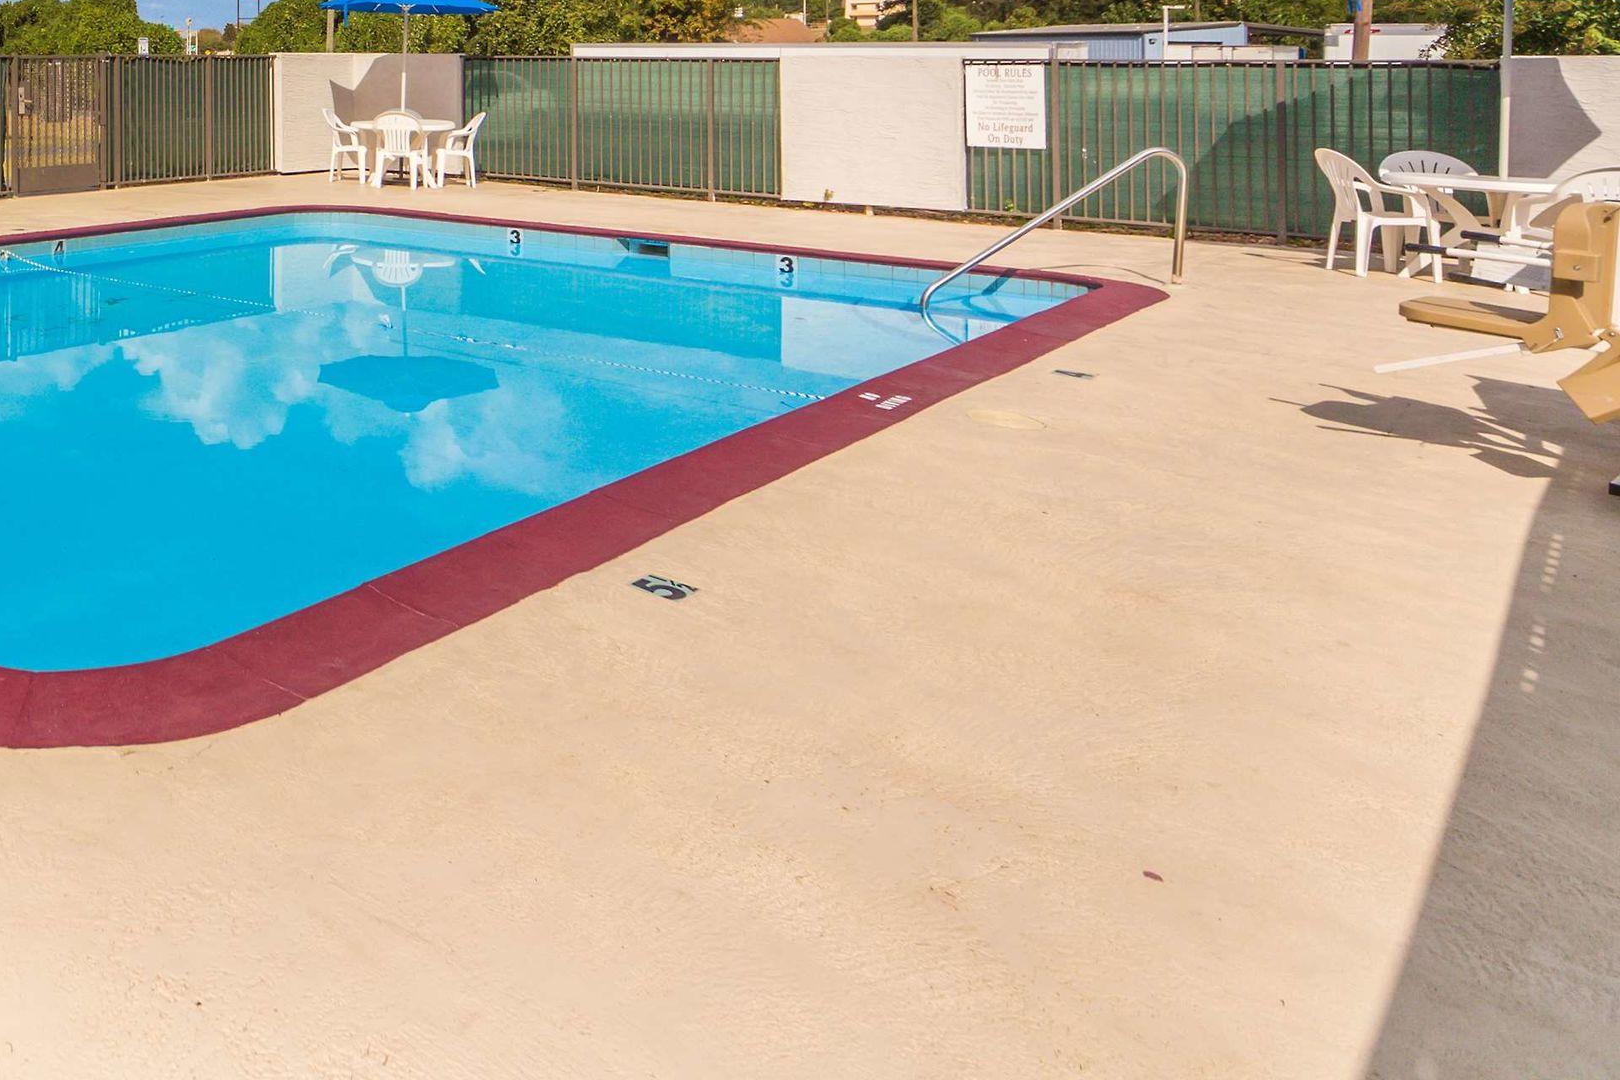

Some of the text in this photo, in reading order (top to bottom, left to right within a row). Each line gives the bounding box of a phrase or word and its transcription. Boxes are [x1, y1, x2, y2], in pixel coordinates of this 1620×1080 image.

[977, 68, 1033, 78] POOL RULES
[977, 122, 1034, 133] No Lifeguard
[987, 134, 1025, 146] On Duty
[509, 229, 521, 244] 3
[779, 256, 794, 273] 3
